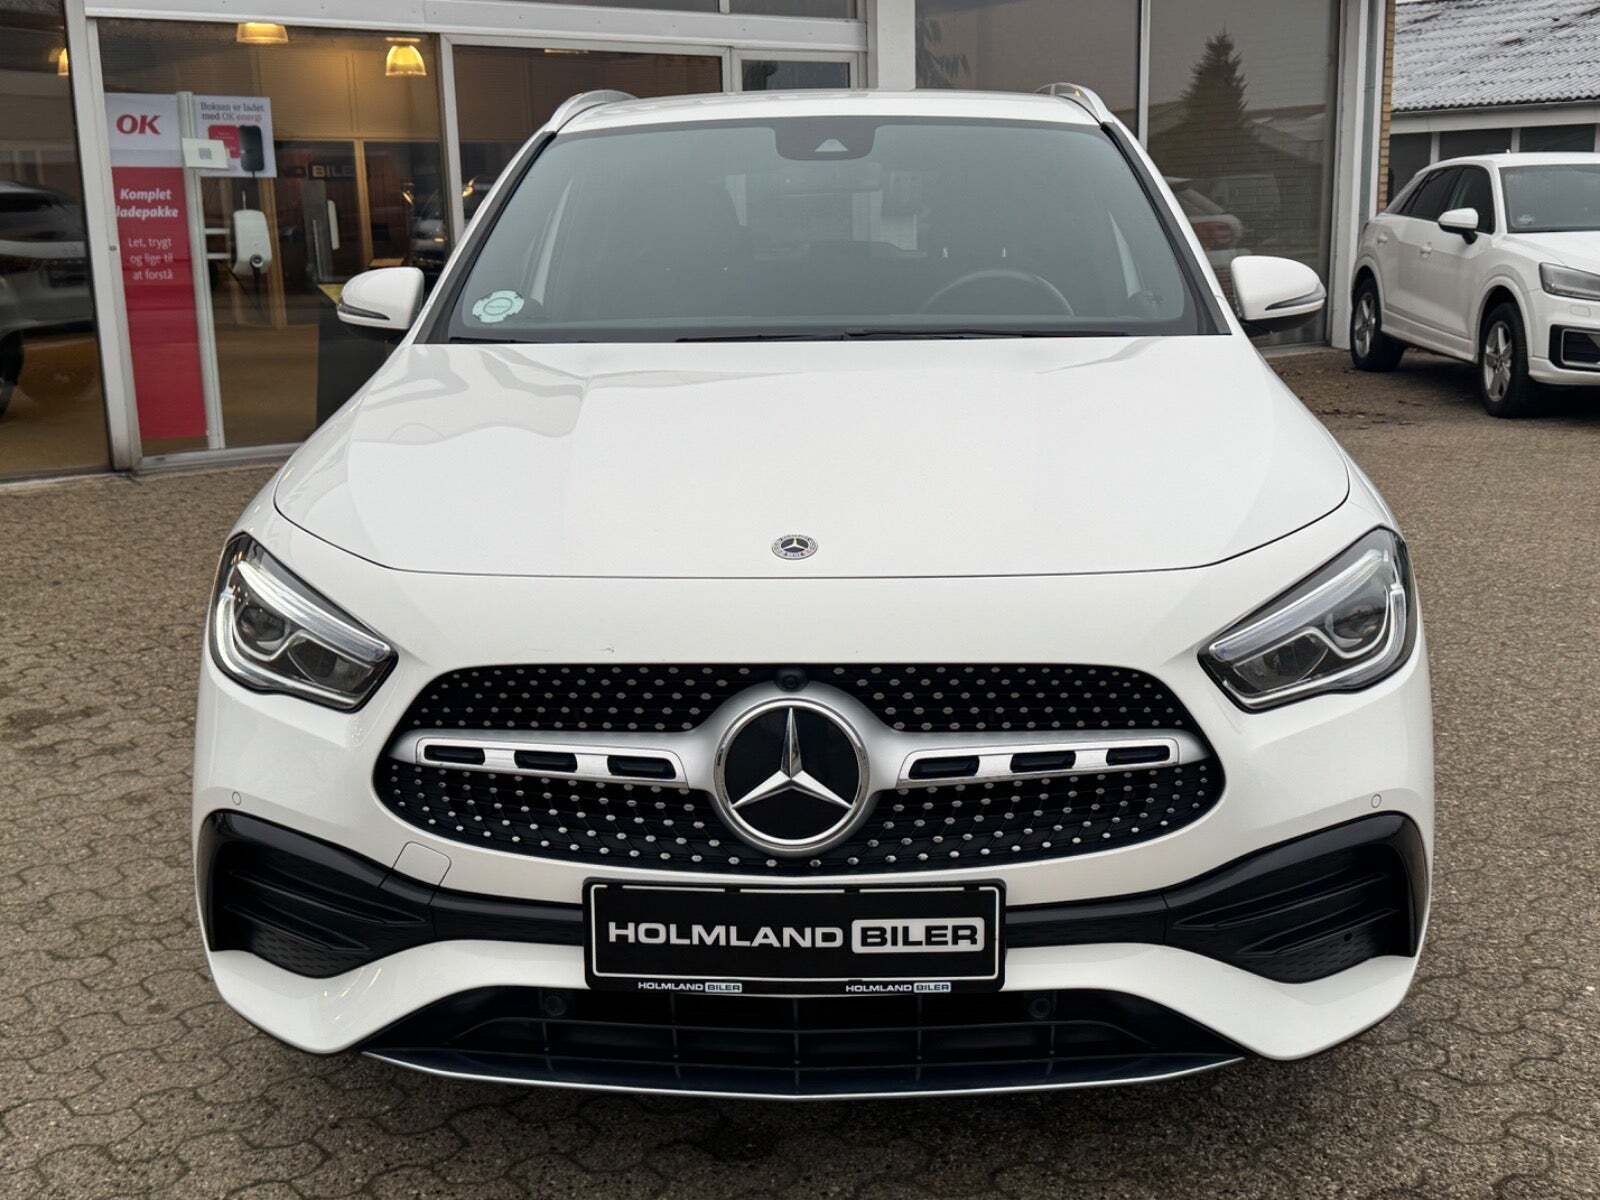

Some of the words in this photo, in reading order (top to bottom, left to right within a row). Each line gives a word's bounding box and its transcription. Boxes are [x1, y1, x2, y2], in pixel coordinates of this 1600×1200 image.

[203, 111, 220, 120] med
[116, 114, 161, 135] OK
[312, 165, 354, 178] BILE
[120, 187, 173, 204] Komplet
[116, 204, 179, 221] ladepakke
[148, 238, 172, 250] trygt
[129, 255, 143, 267] og
[164, 253, 174, 263] til
[133, 271, 143, 280] at
[144, 267, 174, 280] forstå
[608, 921, 844, 949] HOLMLAND
[860, 924, 979, 947] BILER
[638, 981, 704, 992] HOLMLAND
[706, 983, 741, 992] BILER
[845, 984, 912, 993] HOLMLAND
[915, 983, 951, 992] BILER
